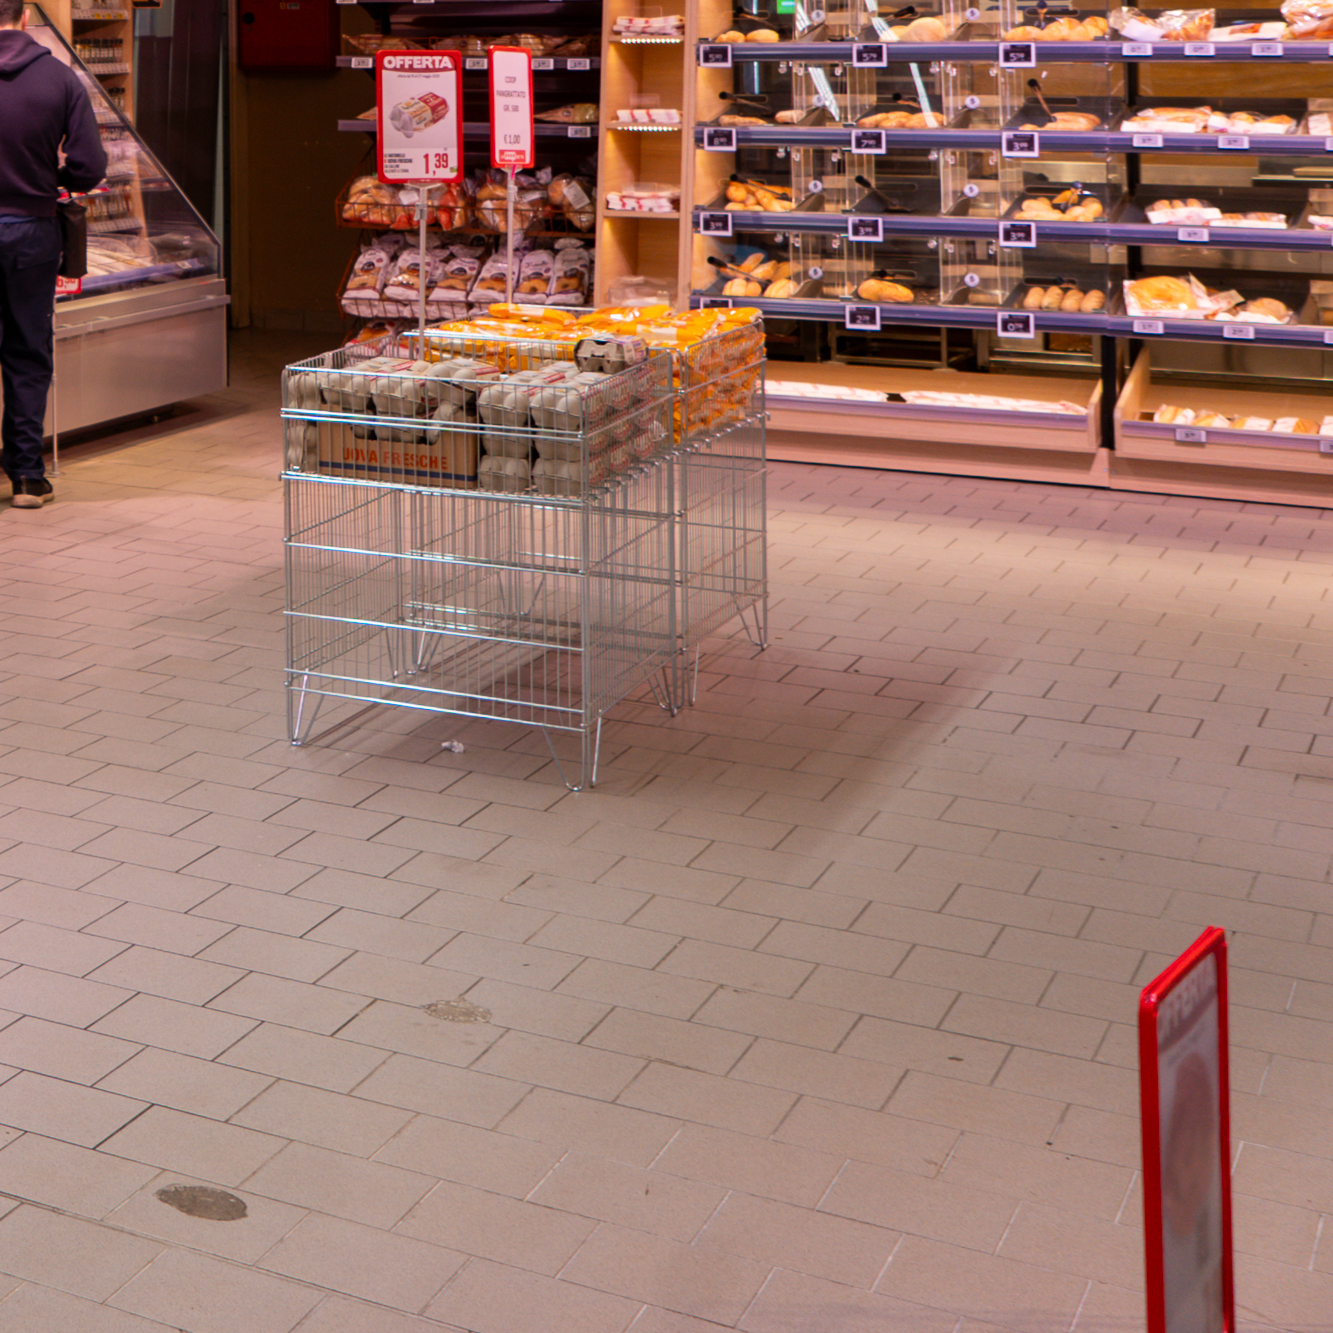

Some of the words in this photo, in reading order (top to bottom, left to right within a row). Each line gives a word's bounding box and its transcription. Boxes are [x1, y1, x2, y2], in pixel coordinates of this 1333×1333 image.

[383, 56, 452, 69] OFFERTA
[496, 90, 526, 98] PANGRATTATO
[423, 153, 448, 176] 1,39
[343, 448, 378, 463] UOVA
[384, 451, 448, 470] FRESCHE
